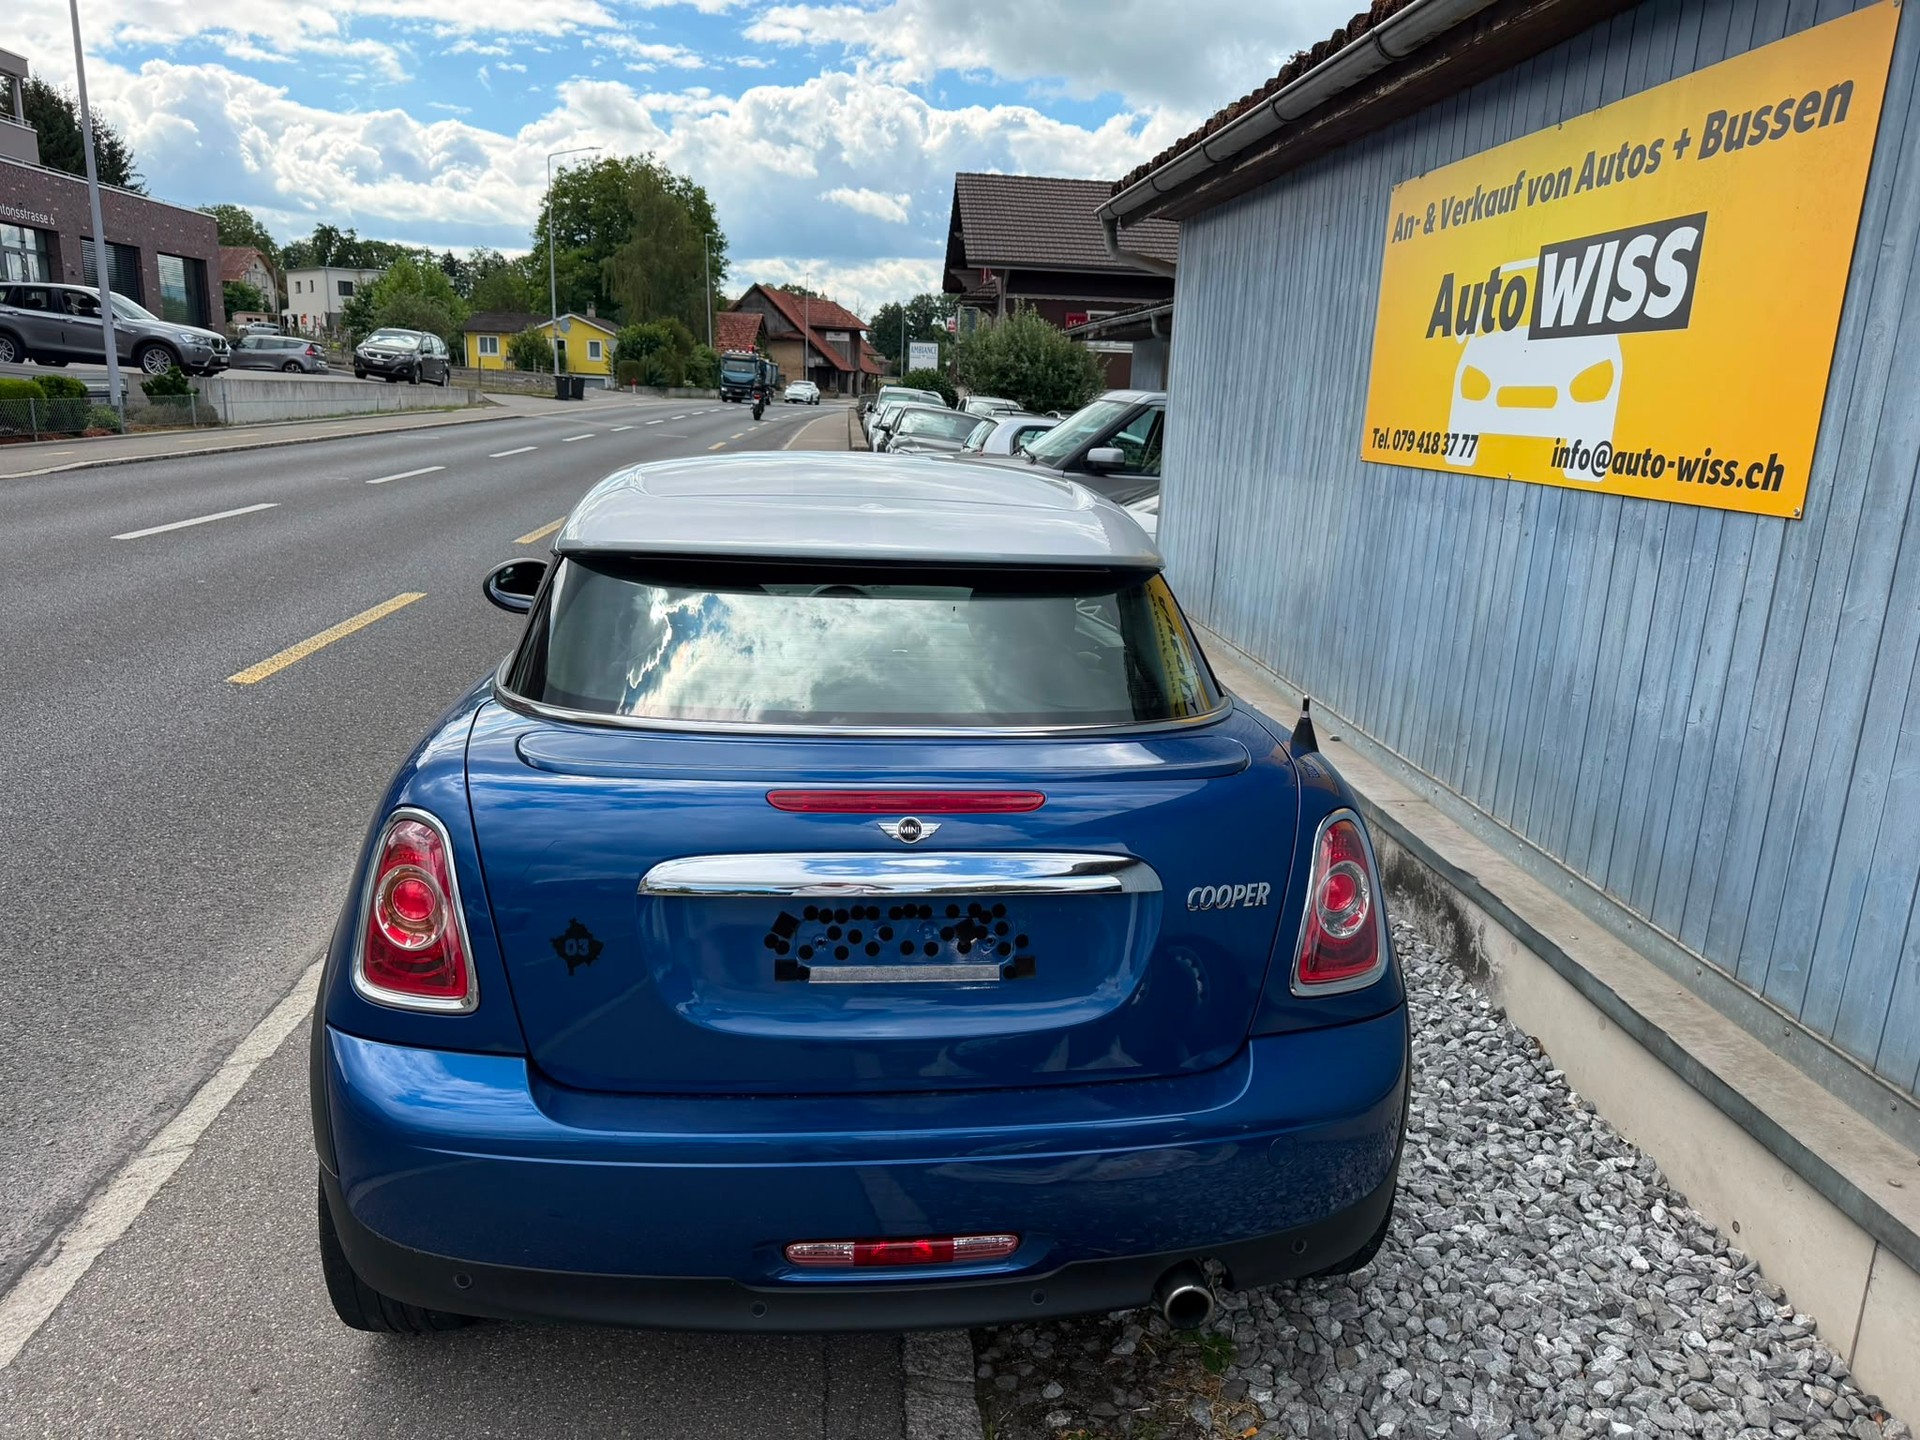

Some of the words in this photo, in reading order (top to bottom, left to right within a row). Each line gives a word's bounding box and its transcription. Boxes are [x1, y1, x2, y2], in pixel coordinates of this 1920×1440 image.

[1391, 212, 1420, 244] An-
[1423, 202, 1436, 235] &
[1440, 170, 1526, 230] Verkauf
[1527, 166, 1573, 207] von
[1573, 138, 1665, 194] Autos
[1673, 128, 1691, 160] +
[1697, 80, 1855, 160] Bussen
[50, 213, 56, 226] 6
[1425, 266, 1527, 338] Auto
[1539, 226, 1699, 328] WISS
[910, 345, 937, 354] AMBIANCE
[1372, 427, 1391, 450] Tel.
[1393, 429, 1415, 452] 079
[1417, 431, 1440, 455] 418
[1441, 432, 1459, 456] 37
[1459, 433, 1479, 458] 77
[1550, 437, 1785, 492] info@auto-wiss.ch
[900, 826, 920, 834] MINI
[1187, 882, 1271, 911] COOPER
